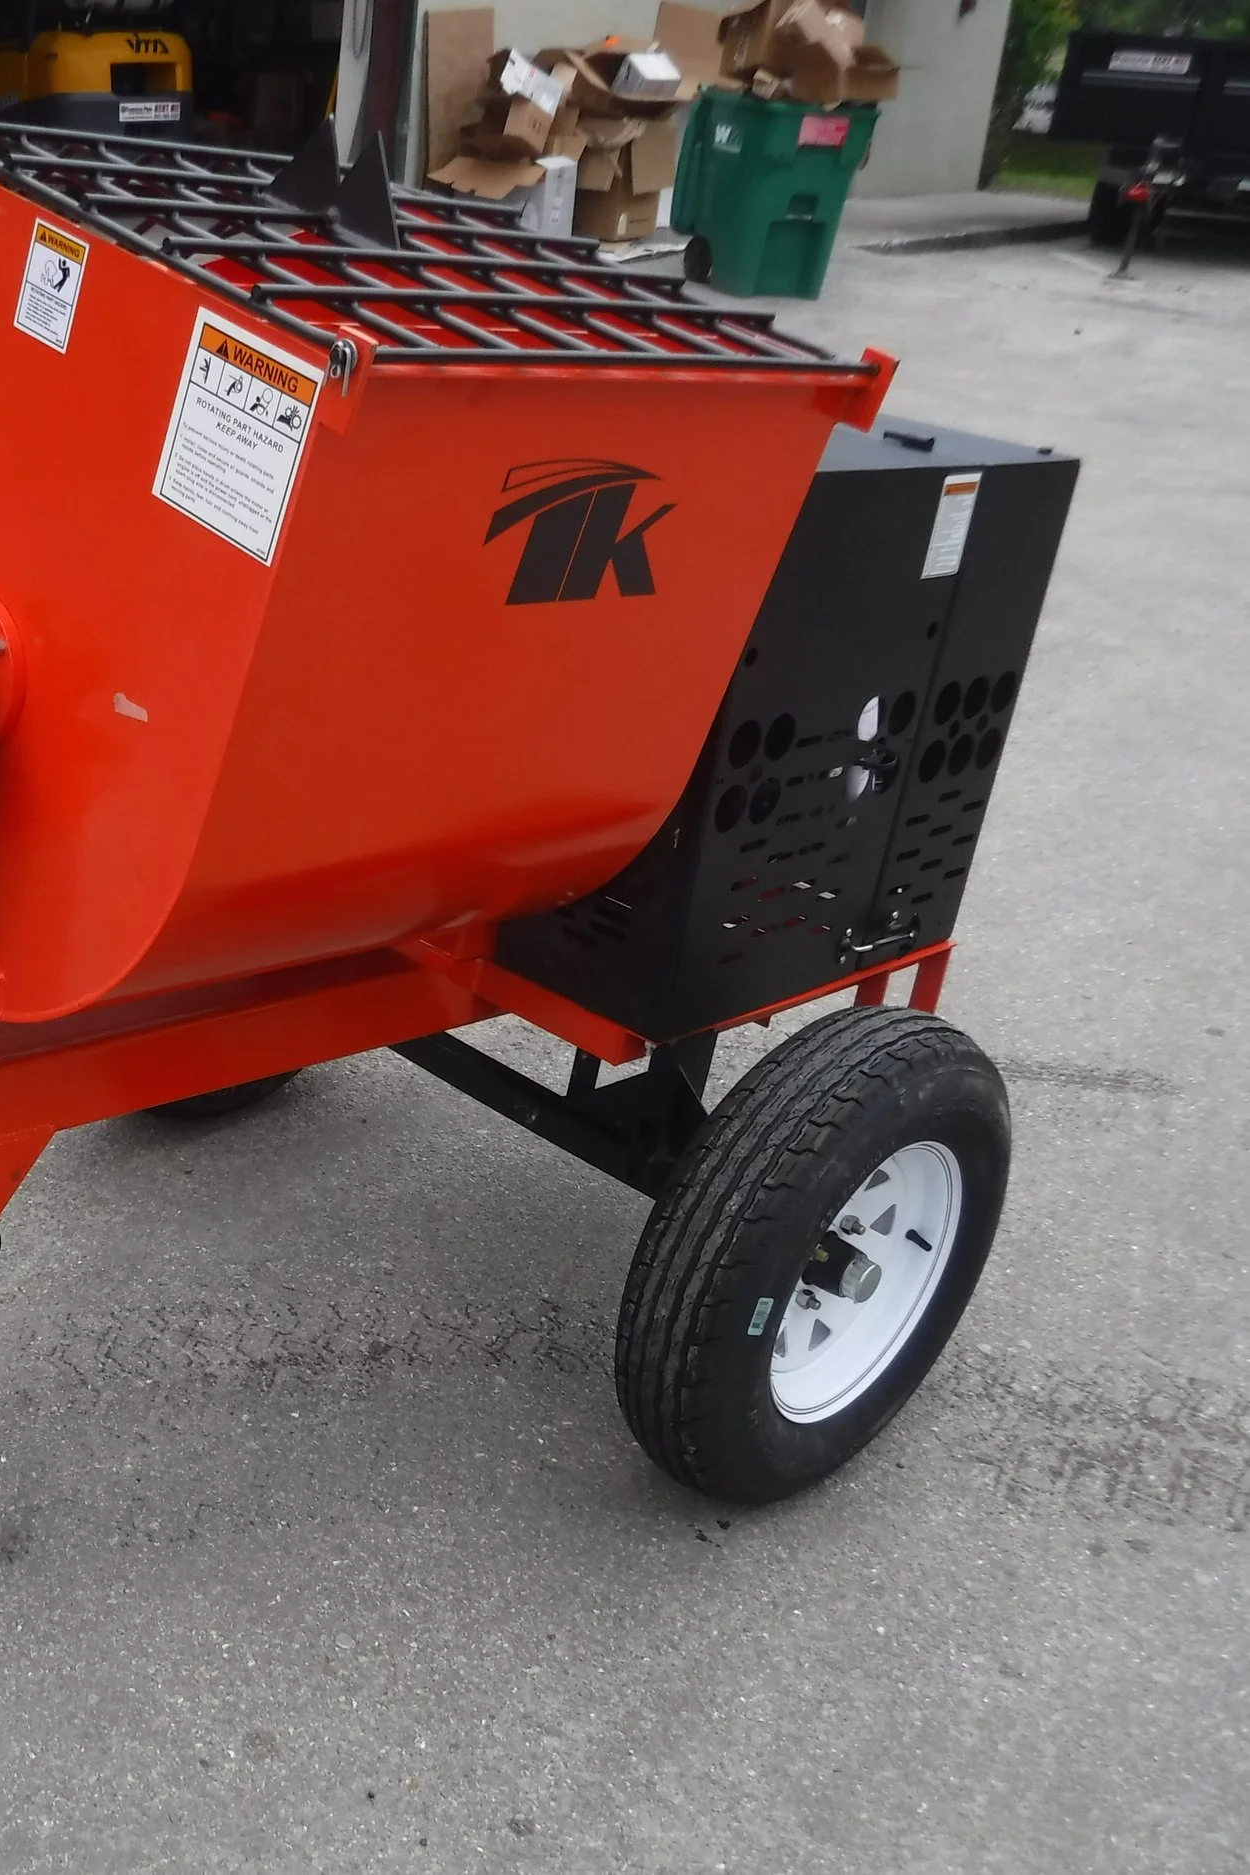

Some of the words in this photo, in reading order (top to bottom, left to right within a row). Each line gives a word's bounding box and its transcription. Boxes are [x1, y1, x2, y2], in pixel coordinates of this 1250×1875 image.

[48, 234, 80, 258] WARNING
[233, 346, 298, 393] WARNING
[196, 396, 231, 423] ROTATING
[232, 417, 251, 434] PART
[252, 429, 284, 453] HAZARD
[216, 421, 235, 438] KEEP
[236, 433, 257, 450] AWAY
[483, 459, 678, 606] TK
